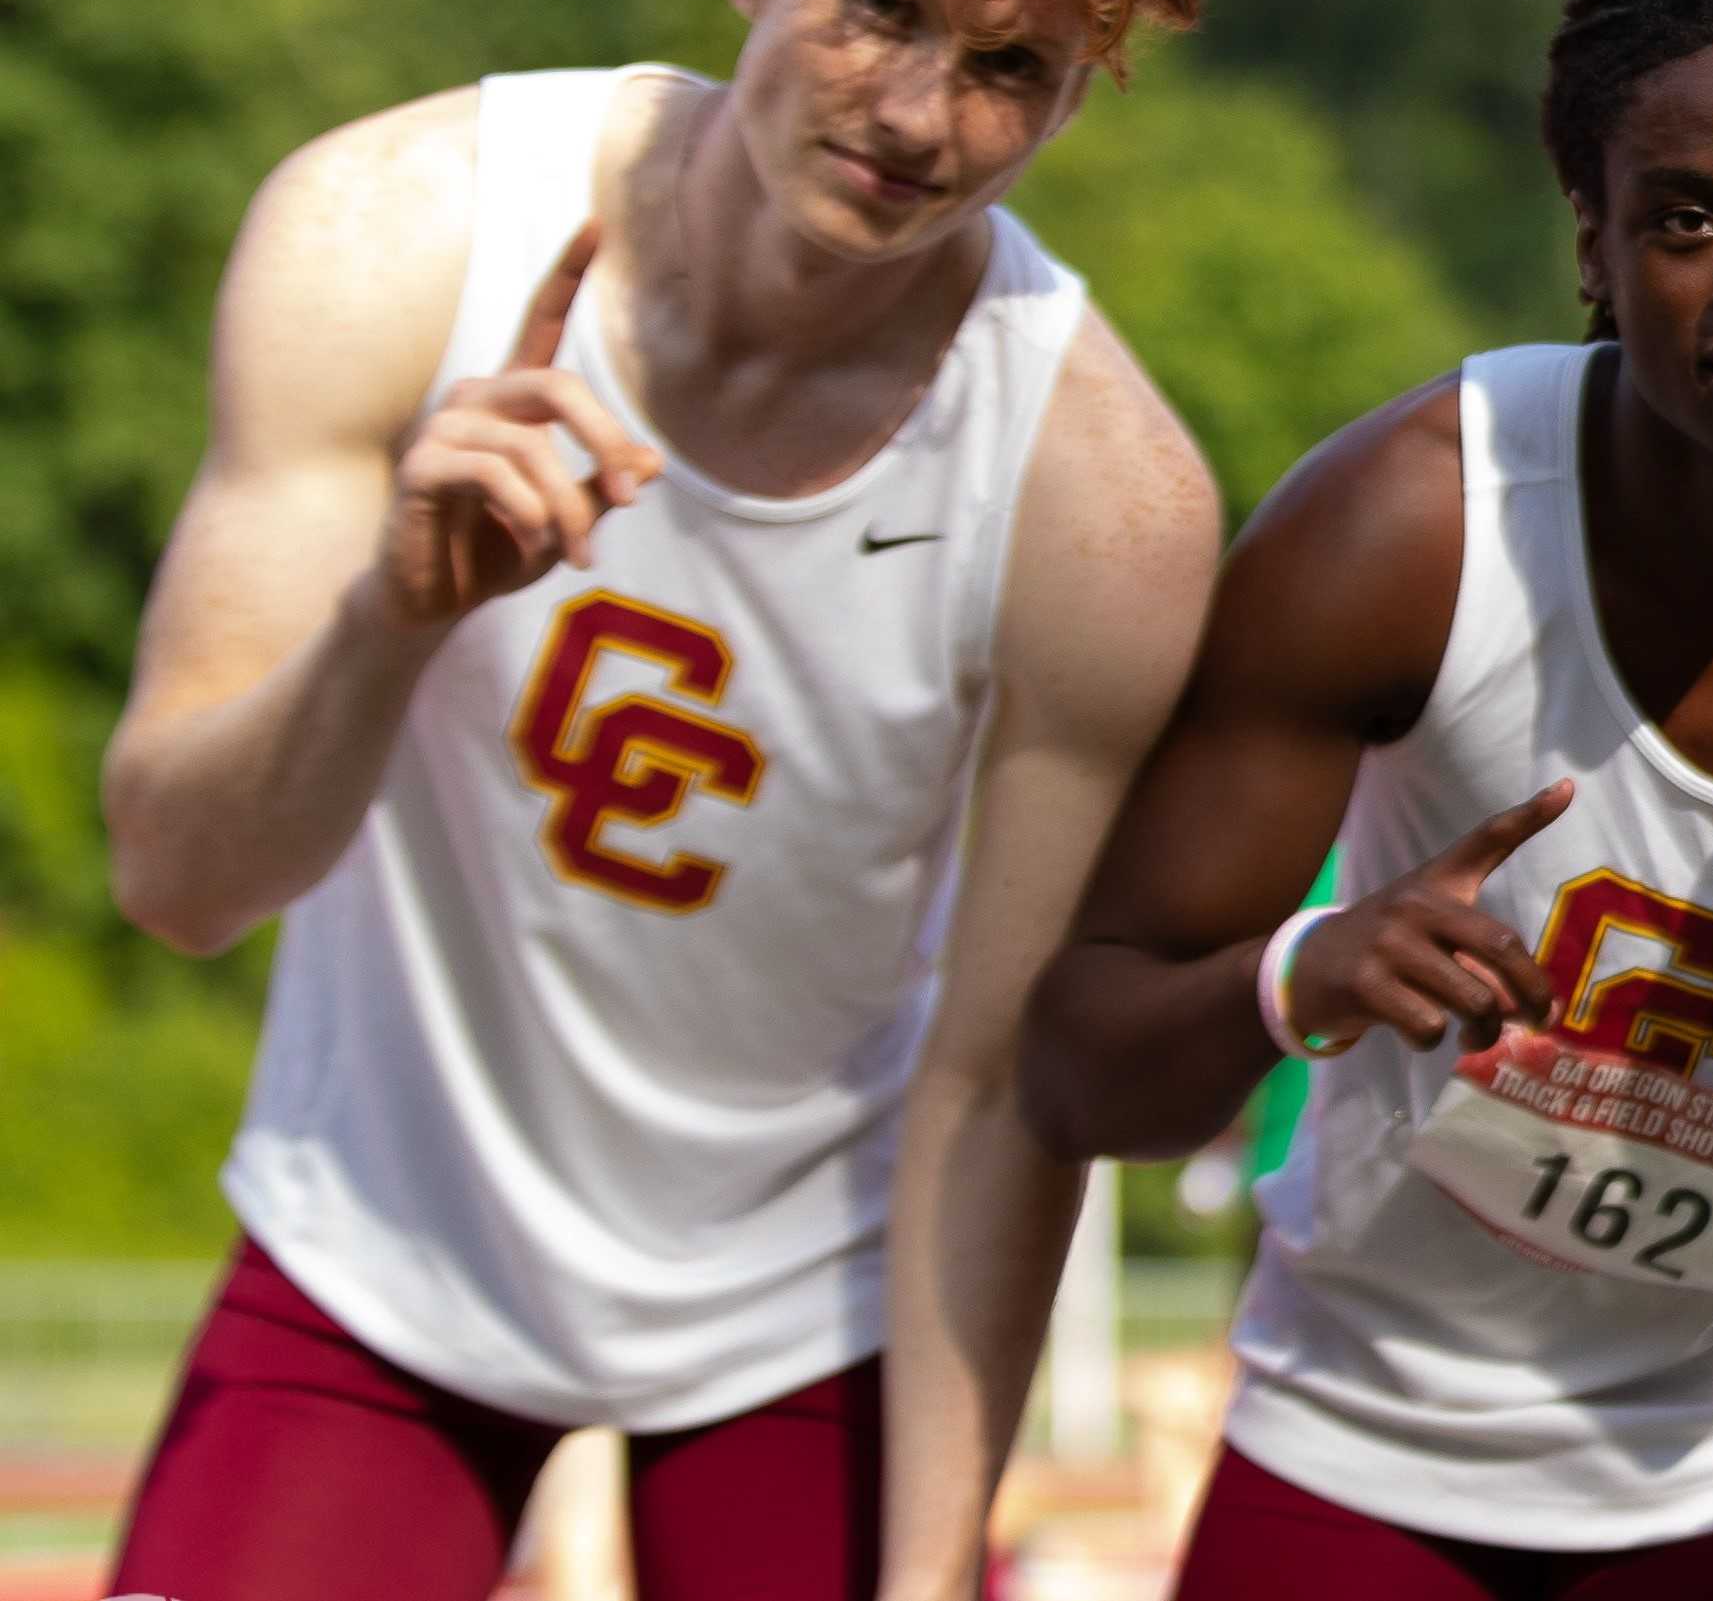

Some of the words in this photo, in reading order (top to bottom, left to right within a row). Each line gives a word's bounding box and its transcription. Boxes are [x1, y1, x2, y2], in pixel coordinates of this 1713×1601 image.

[510, 588, 767, 915] CC
[1490, 1061, 1574, 1116] TRACK
[1572, 1094, 1593, 1122] &
[1593, 1098, 1666, 1134] FIELD
[1588, 1064, 1690, 1112] OREGON
[1520, 1152, 1712, 1280] 162
